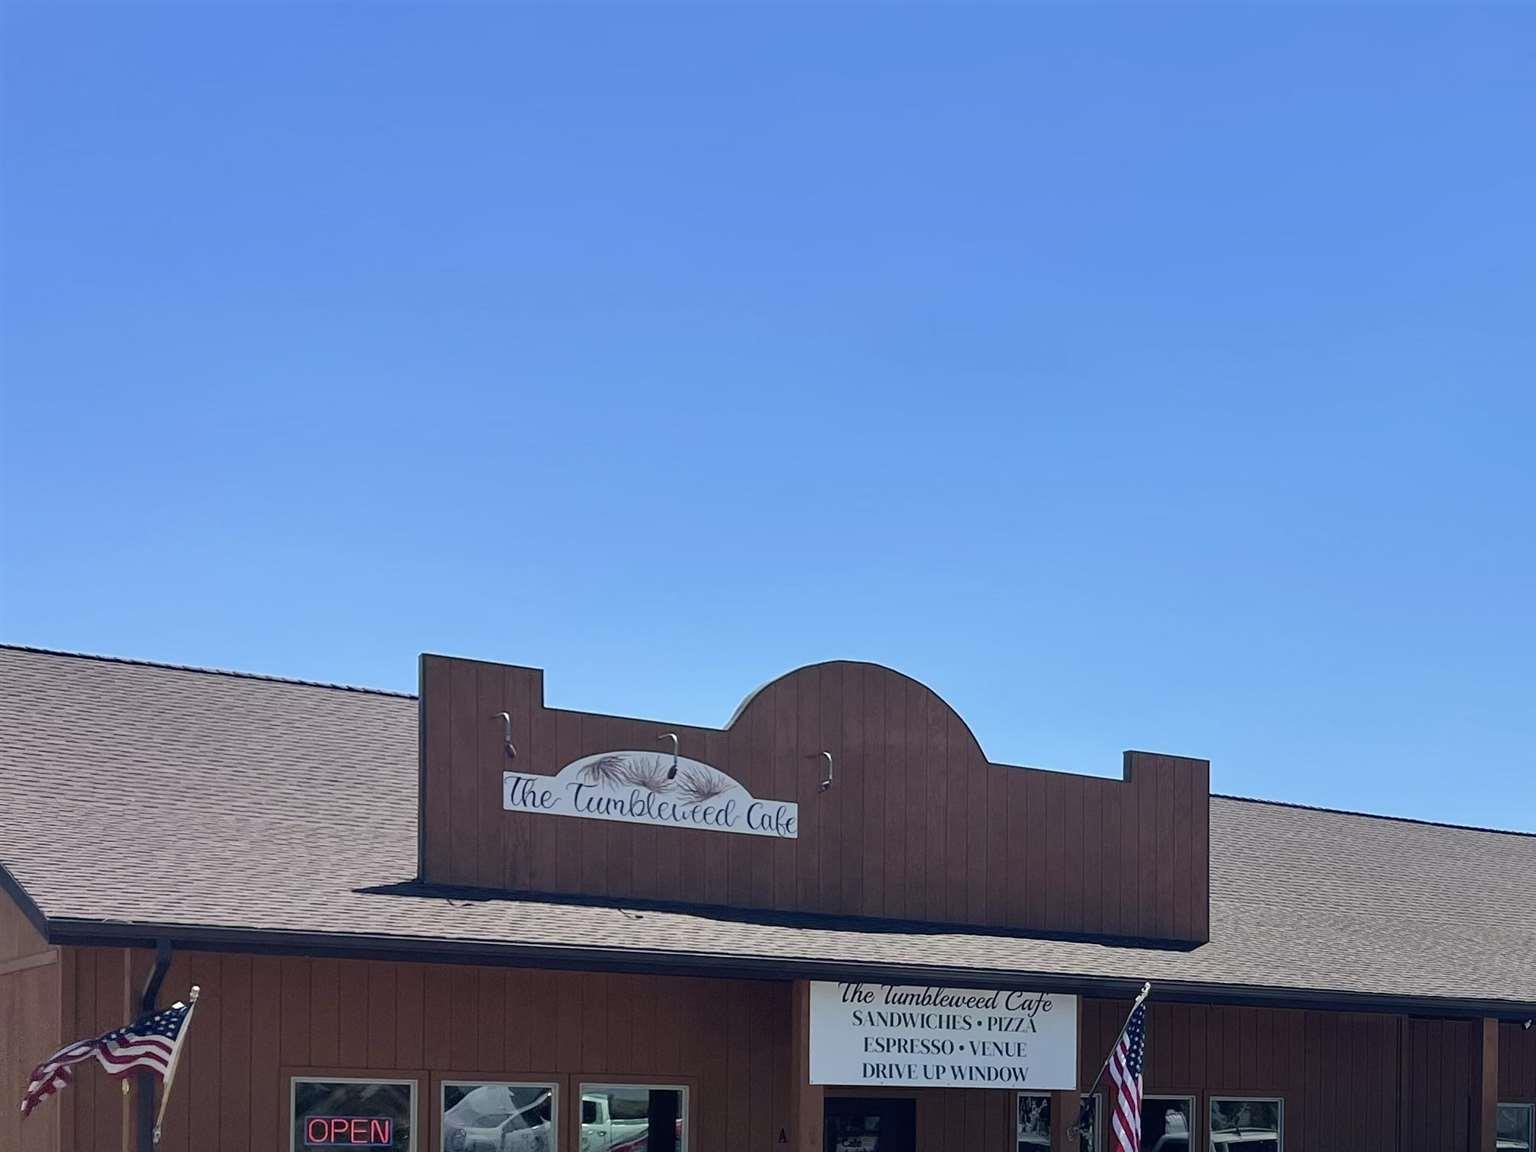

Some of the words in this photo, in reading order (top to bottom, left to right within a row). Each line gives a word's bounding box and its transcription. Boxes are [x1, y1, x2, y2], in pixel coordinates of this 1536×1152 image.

[504, 775, 561, 810] The
[567, 782, 739, 828] Tumbleweed
[746, 802, 798, 839] Cafe
[838, 981, 875, 1004] The
[880, 983, 998, 1010] Tumbleweed
[1005, 991, 1053, 1018] Cafe
[852, 1009, 973, 1032] SANDWICHES
[987, 1016, 1037, 1033] PIZZA
[863, 1036, 955, 1056] ESPRESSO
[969, 1040, 1027, 1058] VENUE
[862, 1062, 919, 1080] DRIVE
[922, 1063, 946, 1081] UP
[950, 1064, 1030, 1083] WINDOW
[308, 1118, 390, 1144] OPEN
